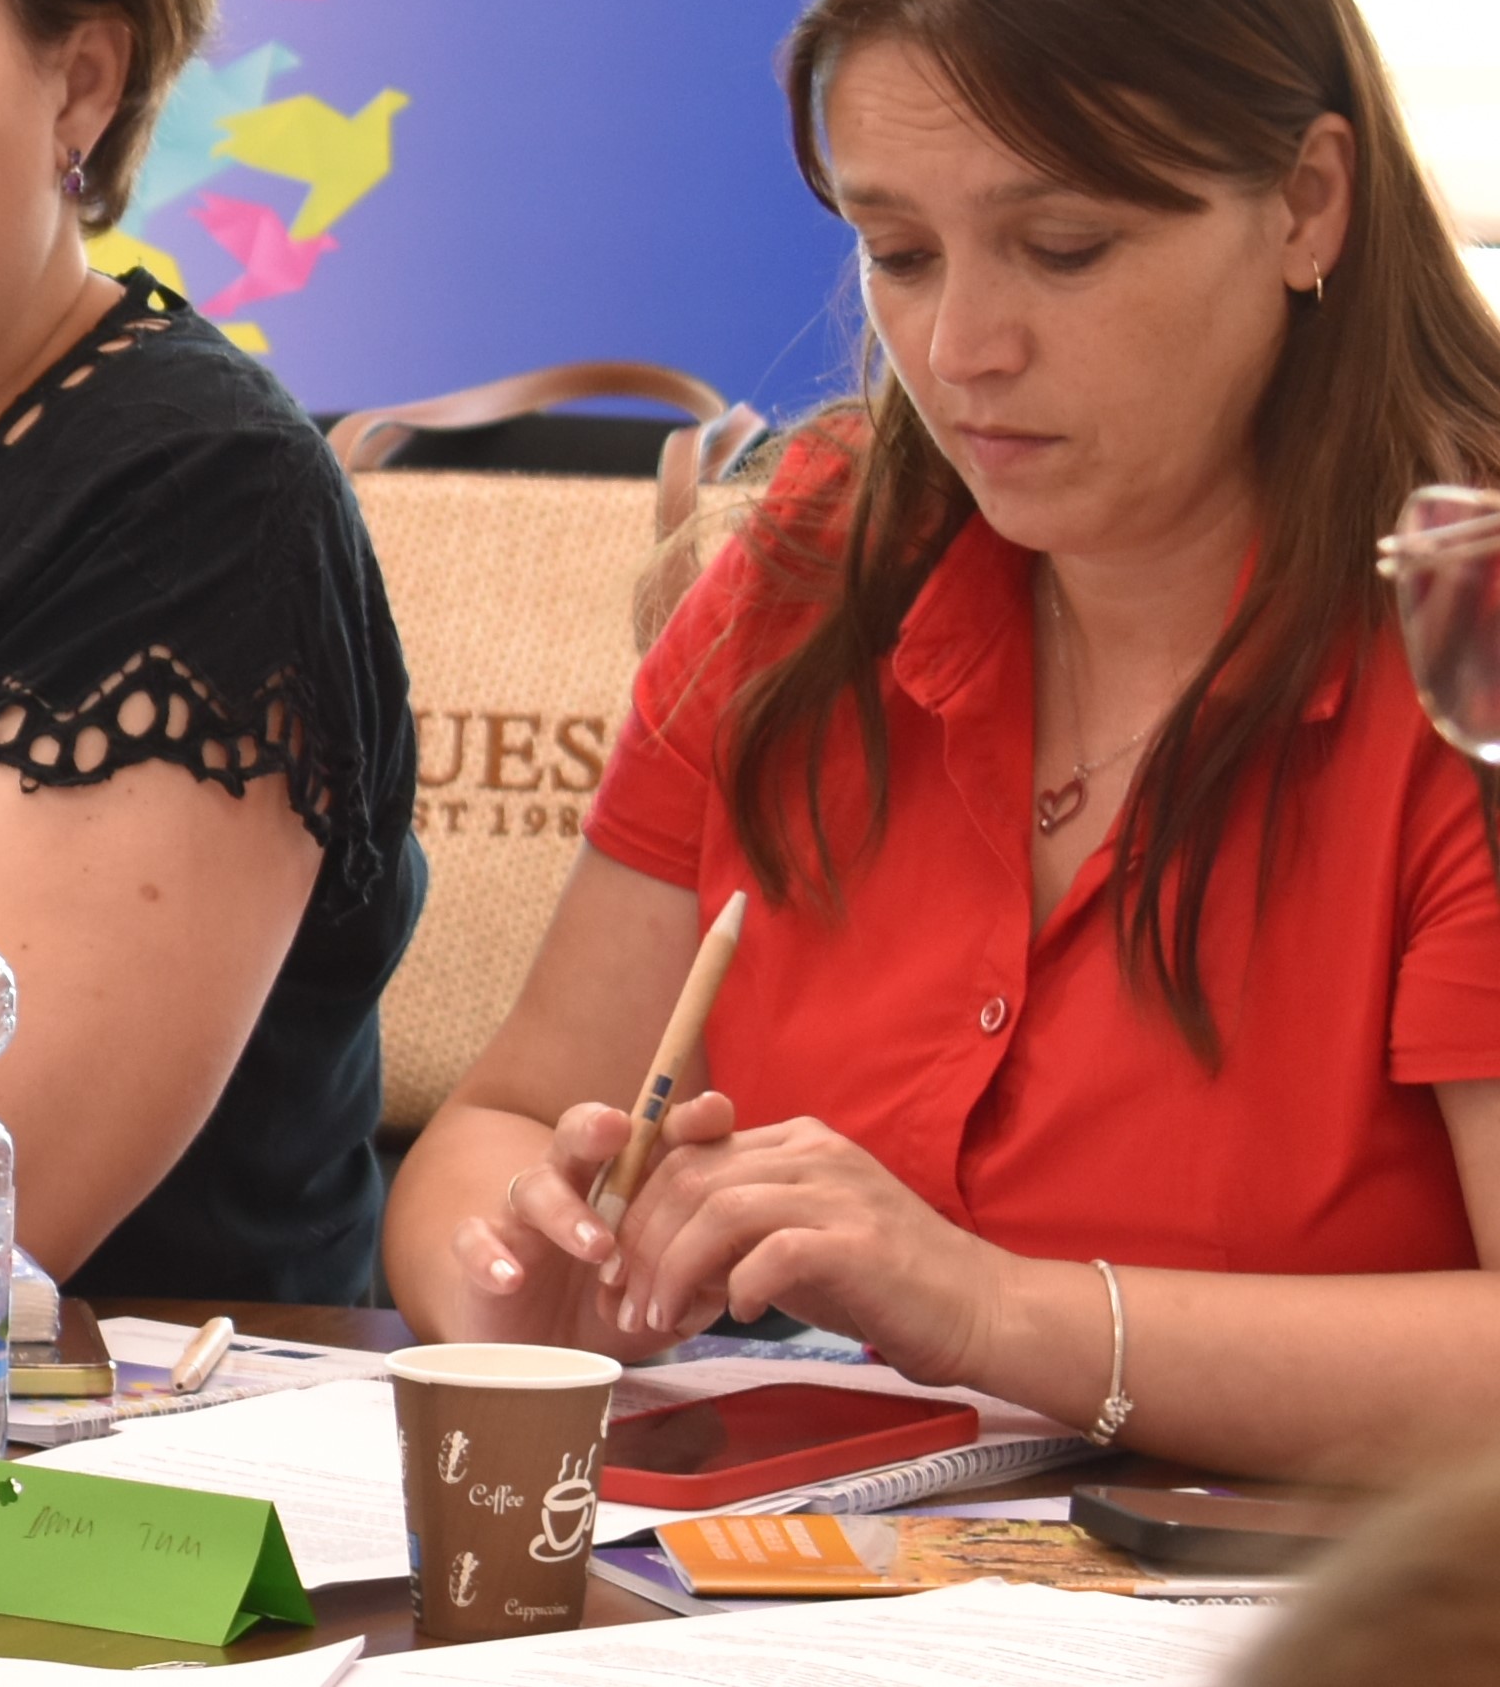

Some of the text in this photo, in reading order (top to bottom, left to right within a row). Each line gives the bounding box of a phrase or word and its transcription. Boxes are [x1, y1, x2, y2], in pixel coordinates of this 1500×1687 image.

[415, 710, 605, 792] UES
[412, 799, 580, 838] ST 198
[469, 1483, 525, 1515] Coffee
